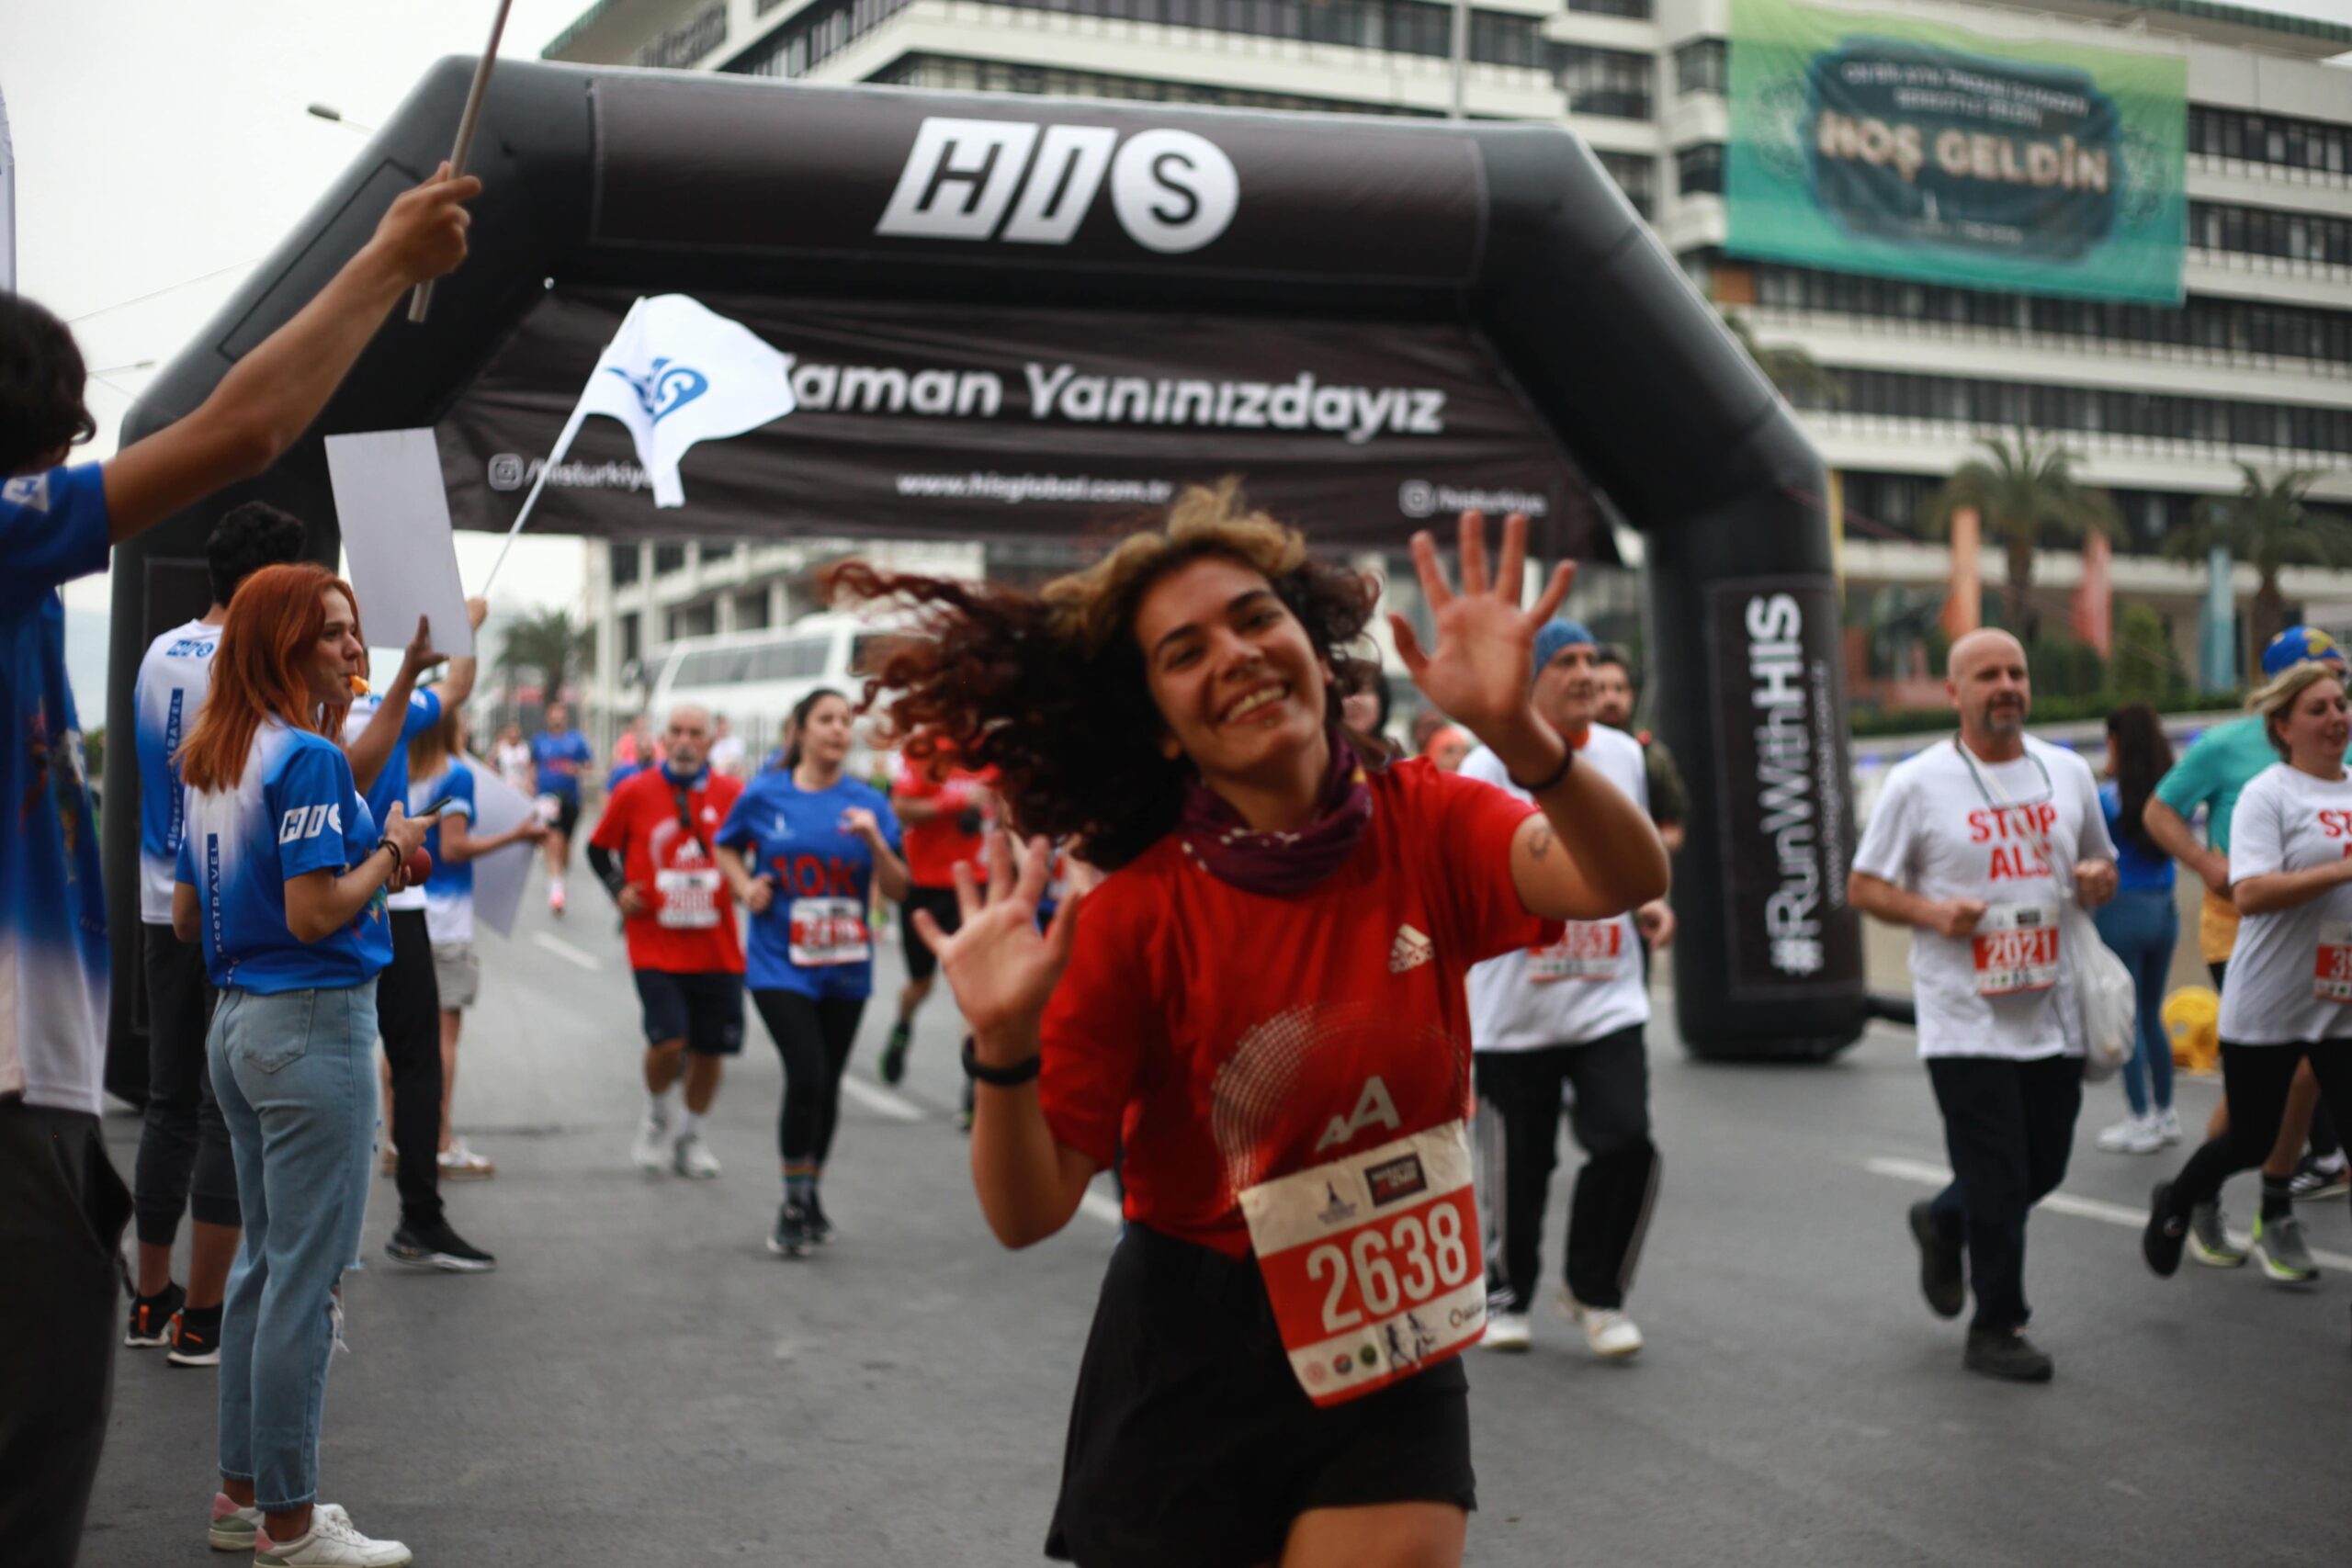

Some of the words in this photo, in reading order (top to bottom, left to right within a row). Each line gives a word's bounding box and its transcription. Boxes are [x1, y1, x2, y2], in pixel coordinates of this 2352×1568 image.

[1817, 107, 1925, 183] HOŞ
[1934, 129, 2109, 193] GELDİN
[790, 363, 1003, 417] aman
[1023, 361, 1447, 444] Yanınızdayız
[1745, 592, 1825, 976] #RunWithHIS
[1305, 1202, 1468, 1335] 2638
